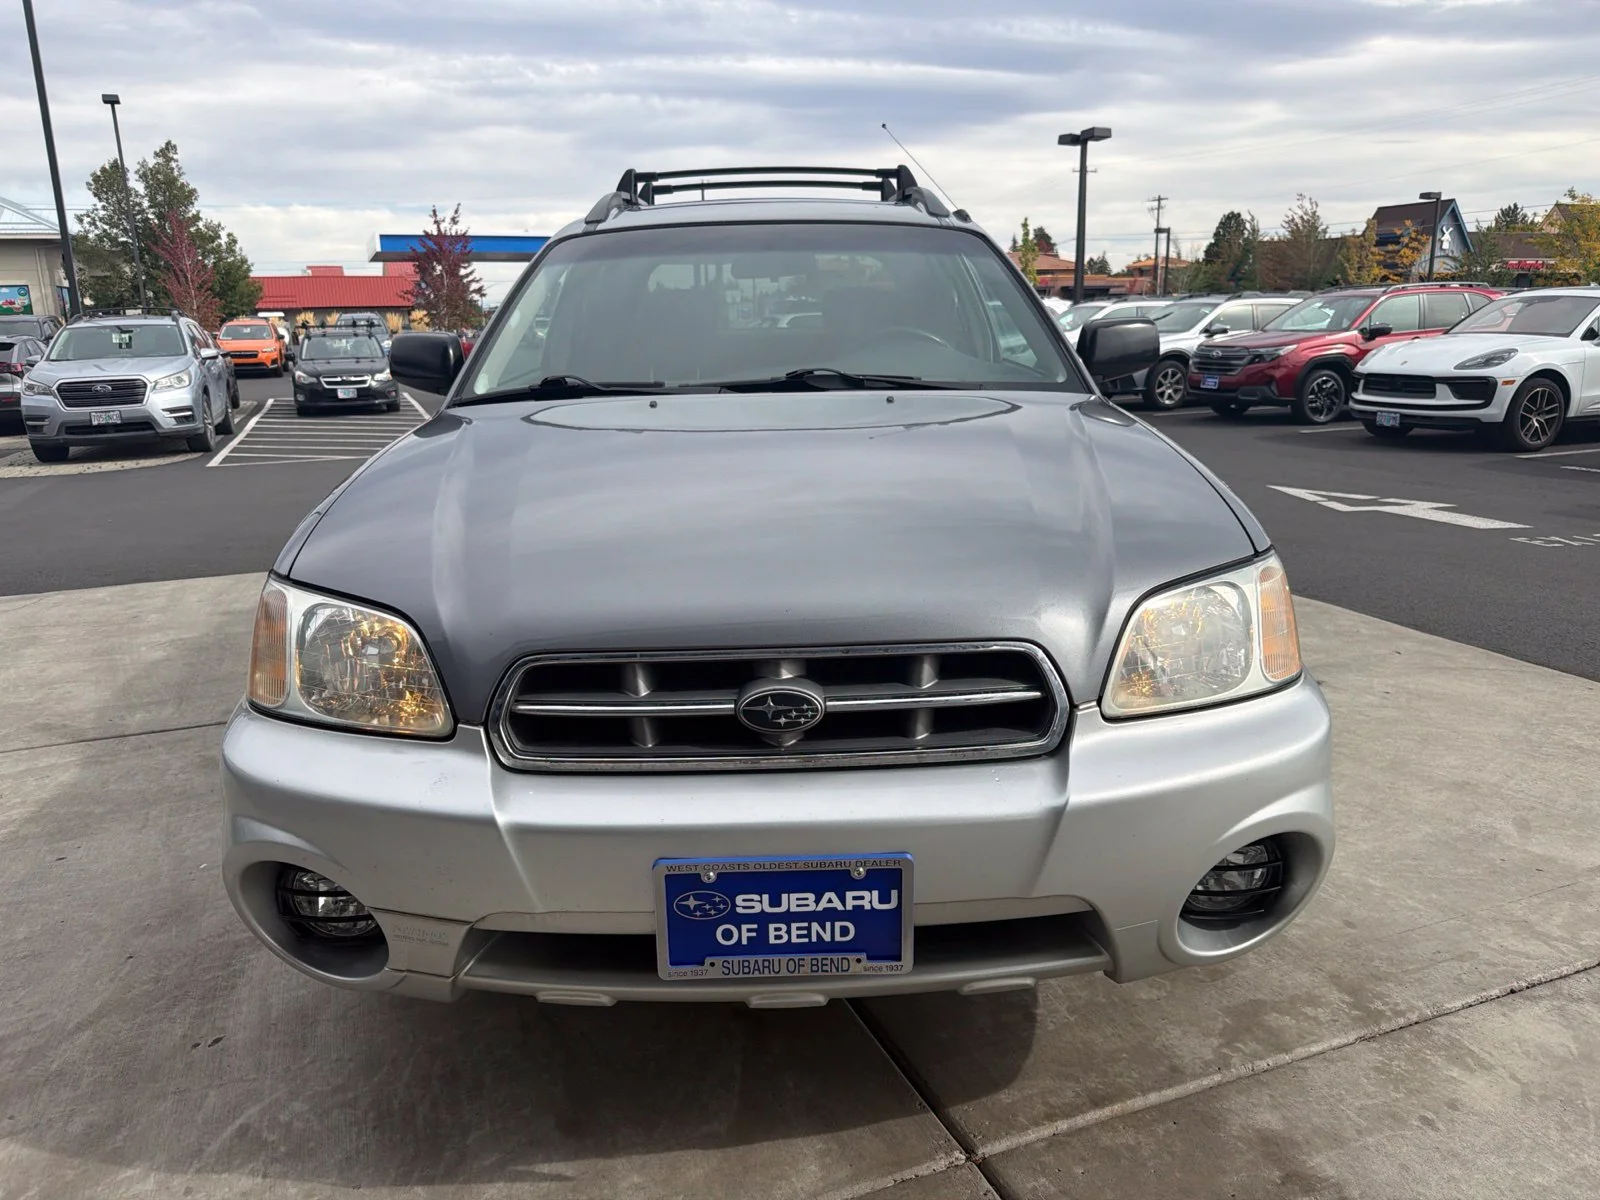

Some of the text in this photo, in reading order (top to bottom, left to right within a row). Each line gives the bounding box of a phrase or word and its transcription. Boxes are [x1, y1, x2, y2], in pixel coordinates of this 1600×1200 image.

[666, 859, 901, 873] WEST COASTS OLDEST SUBARU DEALER
[735, 889, 899, 914] SUBARU
[715, 921, 856, 946] OF BEND
[667, 968, 709, 978] since 1937
[721, 956, 851, 976] SUBARU OF BEND
[885, 964, 904, 972] 1937
